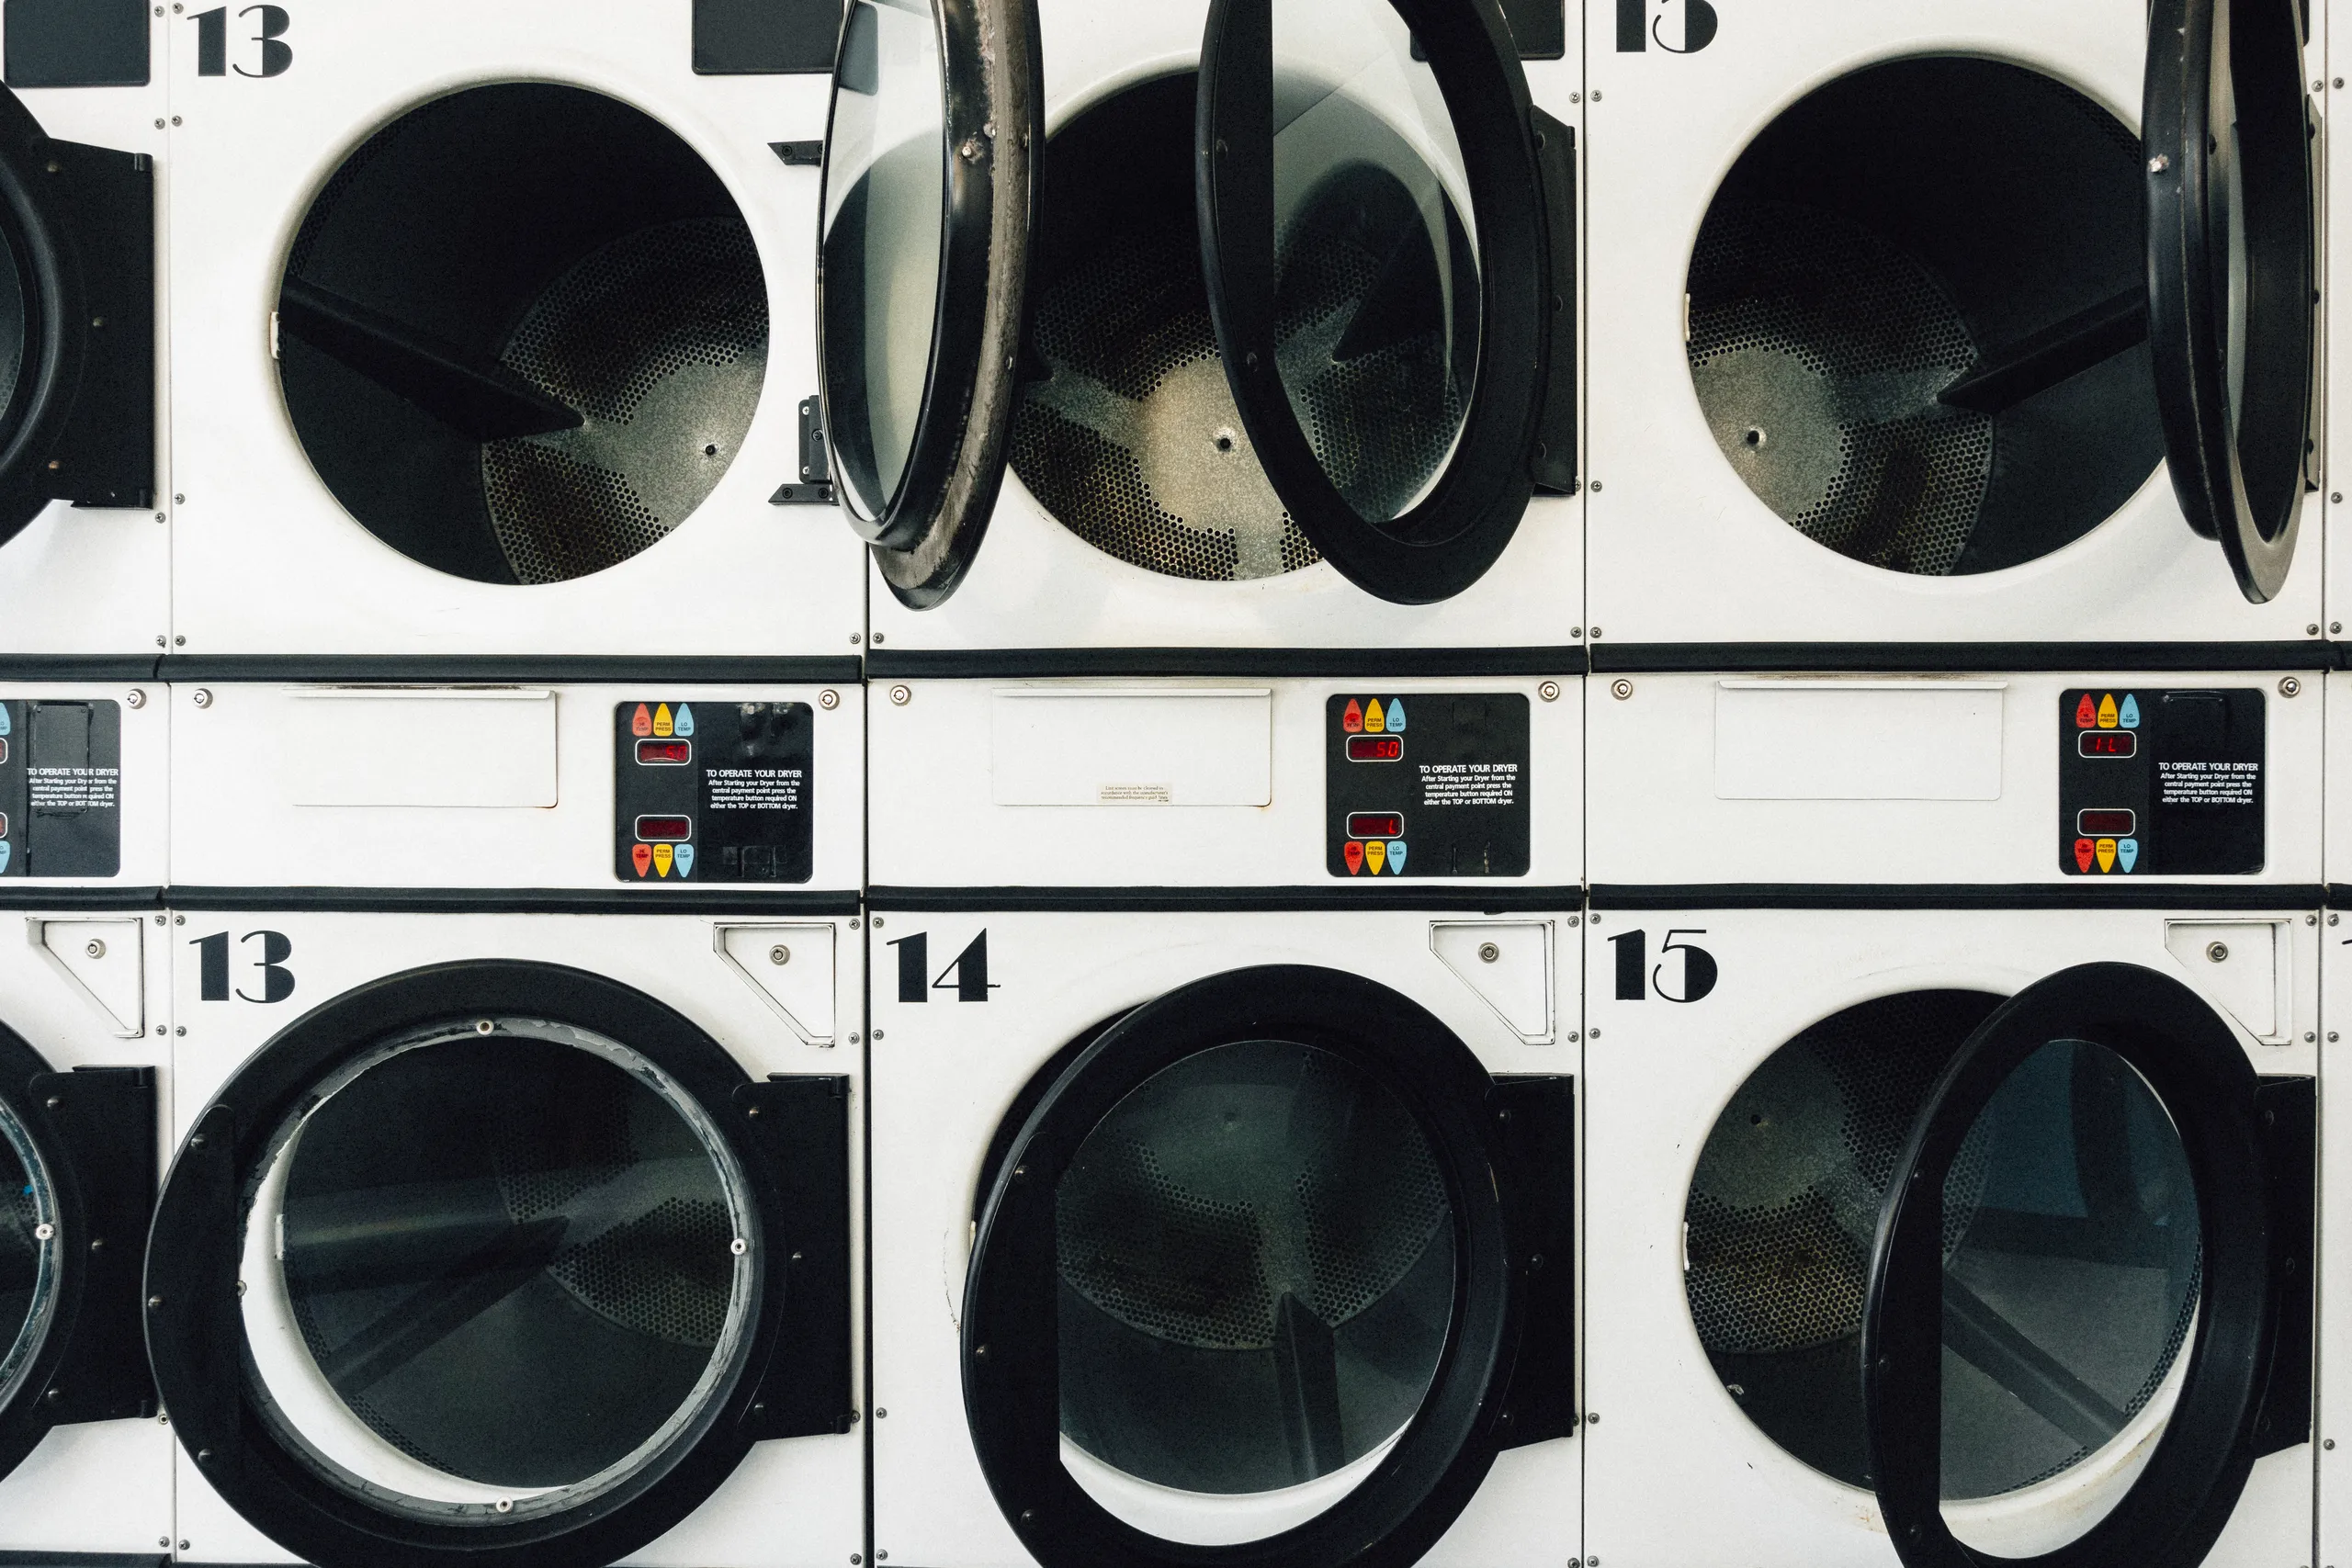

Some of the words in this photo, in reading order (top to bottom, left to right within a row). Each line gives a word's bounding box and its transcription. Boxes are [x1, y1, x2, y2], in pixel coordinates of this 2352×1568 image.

[187, 5, 293, 78] 13
[1376, 741, 1399, 758] 50
[1419, 765, 1430, 773] TO
[1468, 764, 1491, 773] YOUR
[1492, 764, 1518, 773] DRYER
[2158, 762, 2170, 771] TO
[2171, 762, 2207, 771] OPERATE
[2209, 762, 2231, 771] YOUR
[2233, 762, 2258, 771] DRYER
[706, 769, 718, 777] TO
[718, 769, 752, 777] OPERATE
[754, 769, 775, 777] YOUR
[2177, 773, 2199, 781] Starting
[2214, 773, 2230, 781] Dryer
[2219, 788, 2243, 796] required
[1497, 797, 1514, 806] dryer.
[2236, 796, 2253, 805] dryer.
[188, 931, 295, 1003] 13
[887, 928, 1001, 1002] 14
[1607, 929, 1718, 1002] 15
